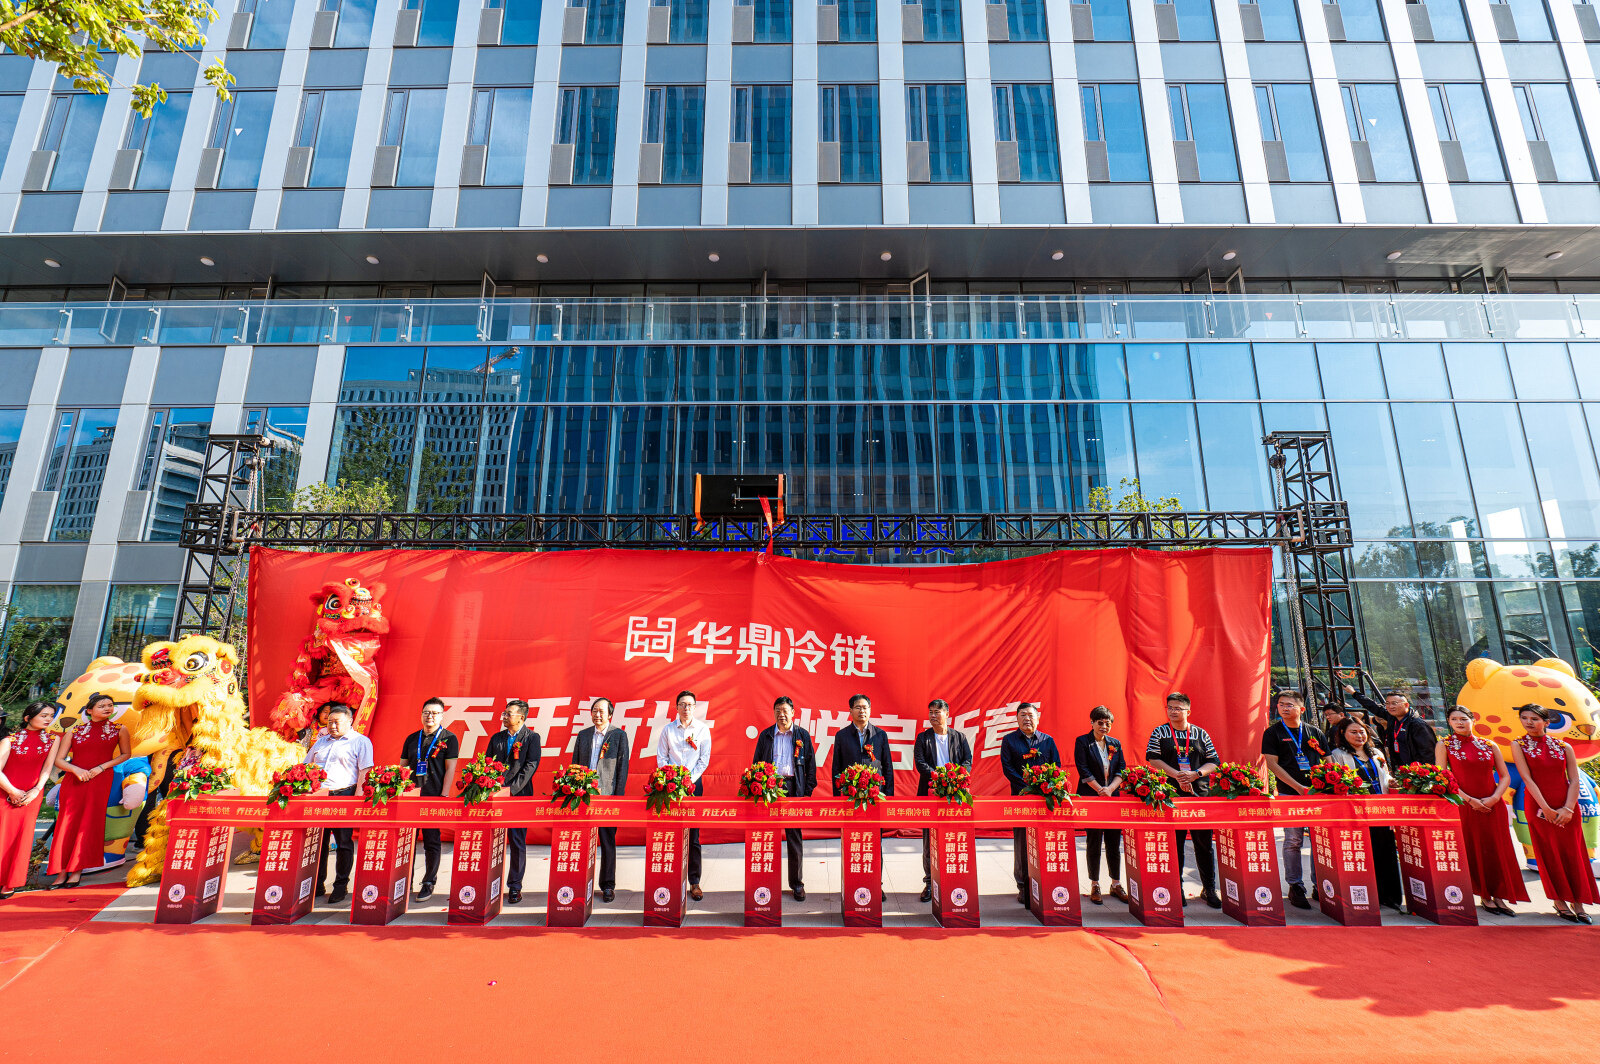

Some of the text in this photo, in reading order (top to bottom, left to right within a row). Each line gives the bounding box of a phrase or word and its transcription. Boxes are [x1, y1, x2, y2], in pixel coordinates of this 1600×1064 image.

[686, 621, 876, 678] 华鼎冷链
[198, 806, 270, 817] 华鼎冷链 乔迁大吉
[313, 807, 389, 816] 华鼎冷链 乔迁大吉
[429, 808, 503, 817] 华鼎冷链 乔迁大吉
[545, 807, 621, 816] 华鼎冷链 乔迁大吉
[702, 808, 737, 817] 乔迁大吉
[780, 807, 855, 817] 华鼎冷链 乔迁大吉
[897, 807, 972, 817] 华鼎冷链 乔迁大吉
[1013, 807, 1088, 817] 华鼎冷链 乔迁大吉
[1172, 809, 1206, 818] 乔迁大吉
[1248, 807, 1323, 817] 华鼎冷链 乔迁大吉
[1364, 805, 1437, 815] 华鼎冷链 乔迁大吉
[171, 829, 188, 870] 华鼎冷链
[183, 829, 199, 870] 乔迁典礼
[264, 830, 281, 871] 华鼎冷链
[278, 830, 294, 871] 乔迁典礼
[363, 830, 376, 871] 华鼎冷链
[375, 830, 388, 871] 乔迁典礼
[458, 830, 471, 871] 华鼎冷链
[470, 830, 483, 872] 乔迁典礼
[557, 831, 570, 872] 华鼎冷链
[570, 831, 582, 872] 乔迁典礼
[651, 831, 663, 873] 华鼎冷链
[664, 831, 675, 873] 乔迁典礼
[751, 831, 762, 873] 华鼎冷链
[763, 831, 774, 873] 乔迁典礼
[850, 832, 861, 873] 华鼎冷链
[862, 832, 874, 873] 乔迁典礼
[945, 832, 957, 874] 华鼎冷链
[957, 832, 969, 874] 乔迁典礼
[1045, 831, 1058, 872] 华鼎冷链
[1056, 831, 1070, 872] 乔迁典礼
[1144, 832, 1158, 873] 华鼎冷链
[1157, 831, 1171, 873] 乔迁典礼
[1245, 831, 1259, 872] 华鼎冷链
[1257, 831, 1272, 872] 乔迁典礼
[1339, 830, 1355, 872] 华鼎冷链
[1352, 830, 1368, 872] 乔迁典礼
[1431, 830, 1448, 872] 华鼎冷链
[1444, 830, 1461, 872] 乔迁典礼
